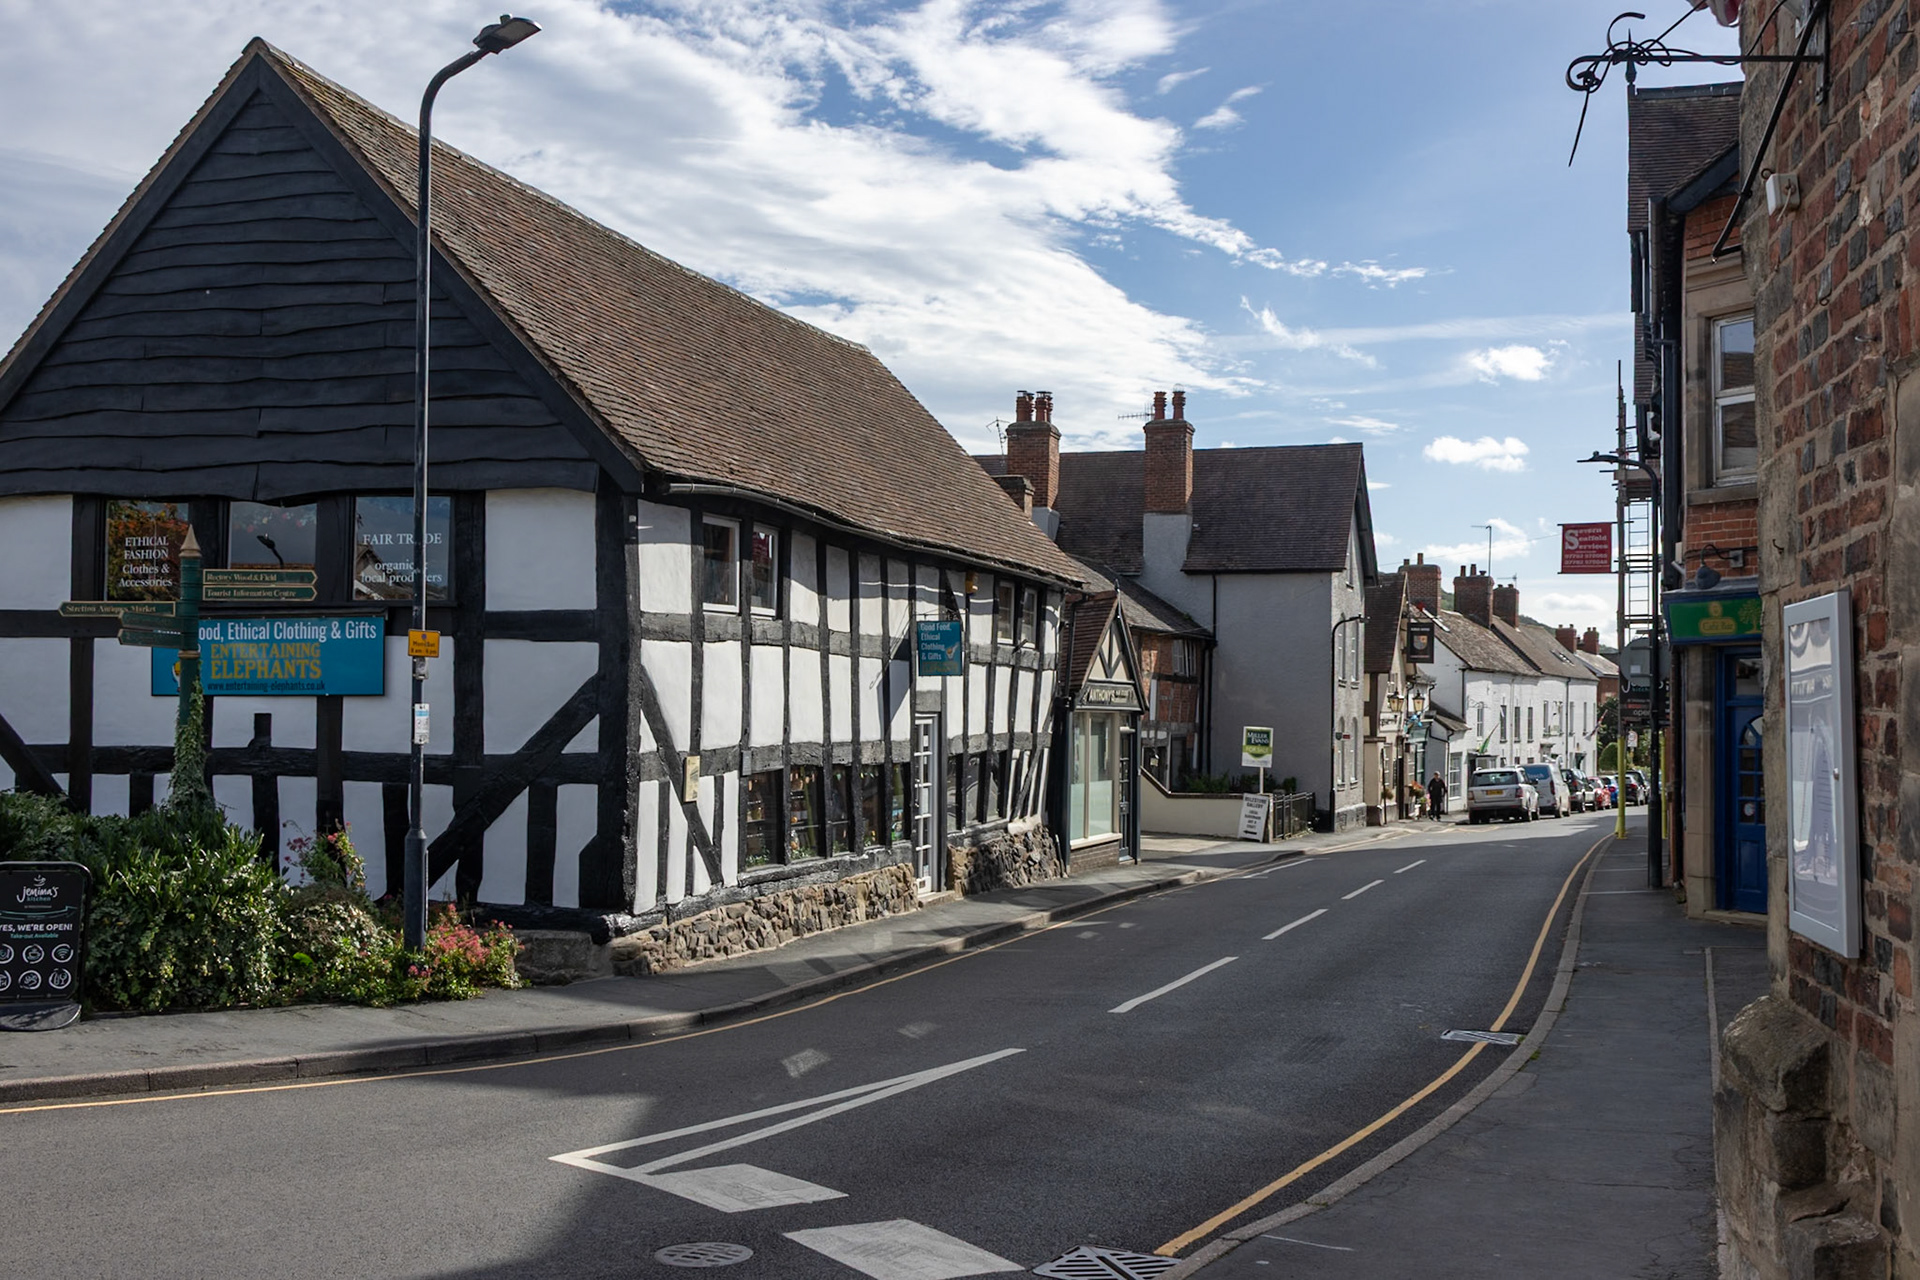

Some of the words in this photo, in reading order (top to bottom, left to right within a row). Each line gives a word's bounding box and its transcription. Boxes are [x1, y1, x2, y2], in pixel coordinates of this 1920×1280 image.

[125, 536, 169, 546] ETHICAL
[363, 534, 393, 544] FAIR
[396, 533, 442, 544] TRDE
[124, 550, 168, 560] FASHION
[122, 564, 159, 574] Clothes
[161, 563, 170, 574] &
[375, 558, 414, 574] organic
[260, 573, 277, 581] Field
[361, 572, 386, 583] local
[388, 572, 442, 587] proders
[119, 578, 172, 587] Accessories
[207, 589, 231, 597] Tourist
[233, 589, 272, 597] Information
[274, 589, 296, 598] Centre
[66, 605, 96, 613] Stretton
[131, 605, 156, 613] Market
[198, 623, 224, 642] ood,
[228, 622, 270, 640] Ethical
[274, 621, 326, 642] Clothing
[330, 621, 341, 640] &
[346, 620, 376, 639] Gifts
[920, 623, 935, 631] Good
[921, 633, 940, 641] Ethical
[210, 642, 321, 659] ENTERTAINING
[921, 643, 946, 652] Clothing
[922, 652, 926, 660] &
[928, 652, 942, 660] Gifts
[210, 660, 322, 680] ELEPHANTS
[207, 680, 326, 693] www.entertaining-elephants.co.uk
